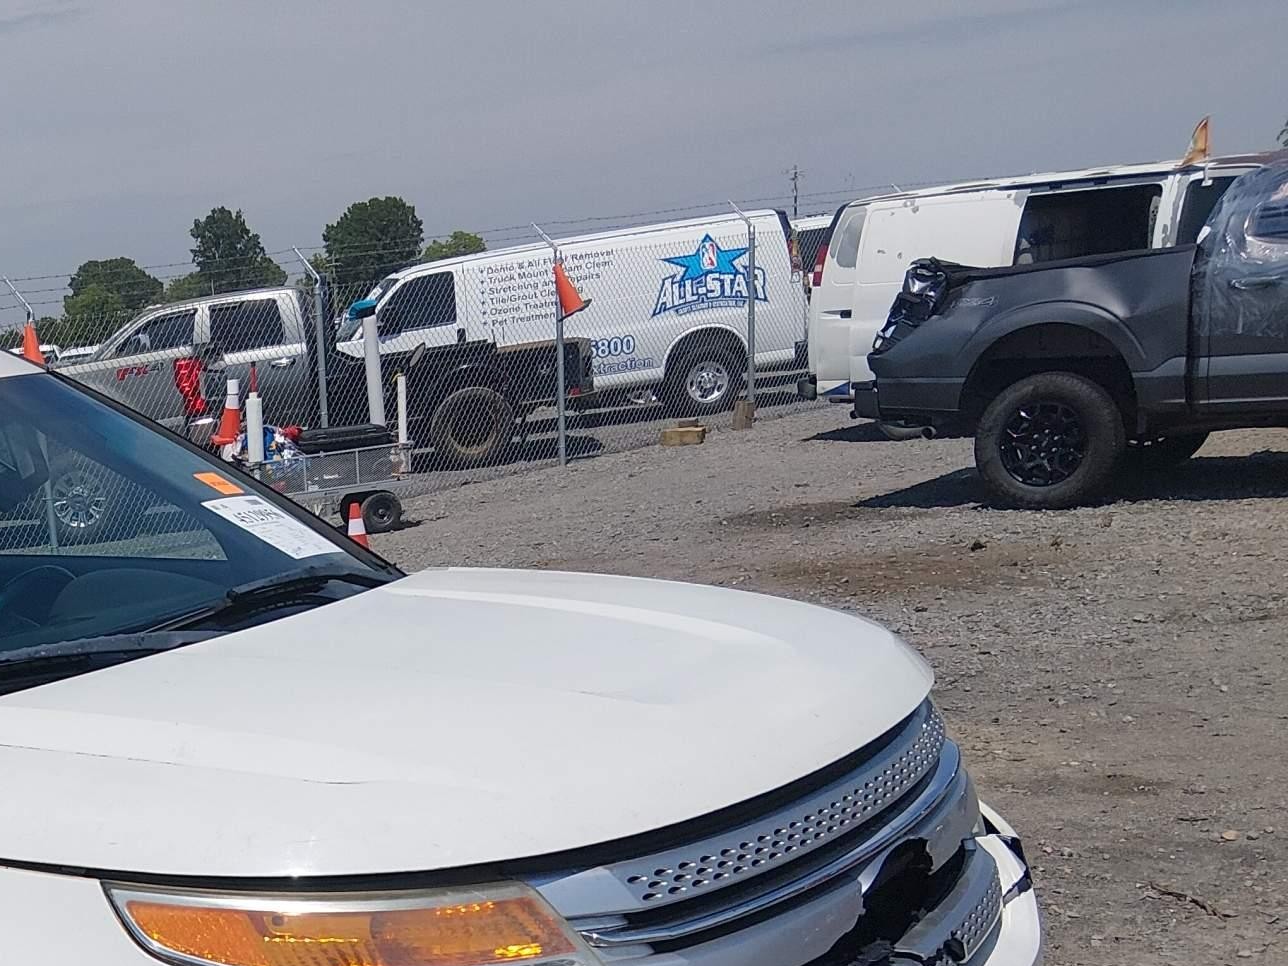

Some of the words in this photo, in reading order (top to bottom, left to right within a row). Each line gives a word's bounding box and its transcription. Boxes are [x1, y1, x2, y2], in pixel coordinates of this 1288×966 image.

[570, 249, 614, 262] Removal
[488, 274, 516, 285] Truck
[518, 268, 549, 280] Mount
[585, 259, 614, 270] Clean
[488, 280, 539, 296] Stretching
[651, 265, 769, 318] ALL-STAR
[492, 315, 509, 327] Pet
[592, 356, 654, 378] xtraction
